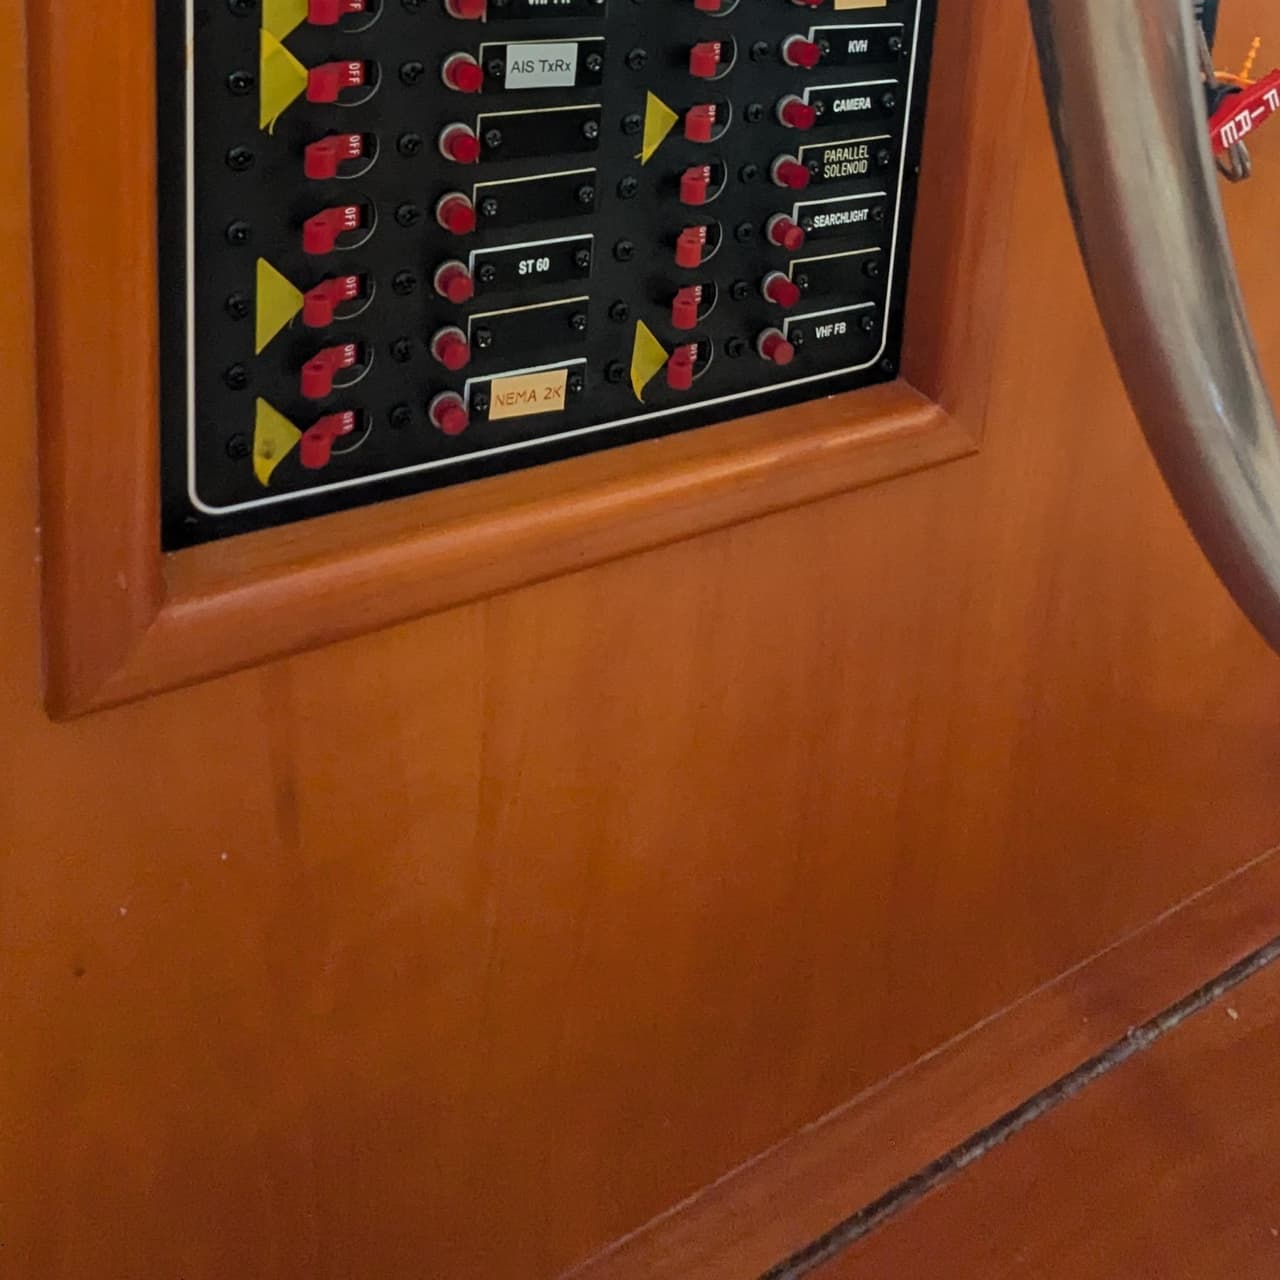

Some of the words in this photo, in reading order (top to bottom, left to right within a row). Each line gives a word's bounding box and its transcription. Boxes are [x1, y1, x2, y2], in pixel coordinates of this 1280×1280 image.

[848, 39, 868, 53] KVH
[348, 62, 361, 85] OFF
[510, 59, 535, 74] AIS
[538, 57, 572, 73] TxRx
[833, 97, 872, 113] CAMERA
[348, 135, 360, 156] OFF
[824, 145, 870, 163] PARALLEL
[824, 161, 868, 179] SOLENOID
[344, 207, 357, 228] OFF
[814, 209, 869, 228] SEARCHLIGHT
[518, 260, 534, 276] ST
[536, 257, 550, 272] 60
[345, 275, 357, 297] OFF
[815, 325, 832, 339] VHF
[344, 343, 355, 364] OFF
[494, 389, 538, 407] NEMA
[543, 384, 564, 401] 2K
